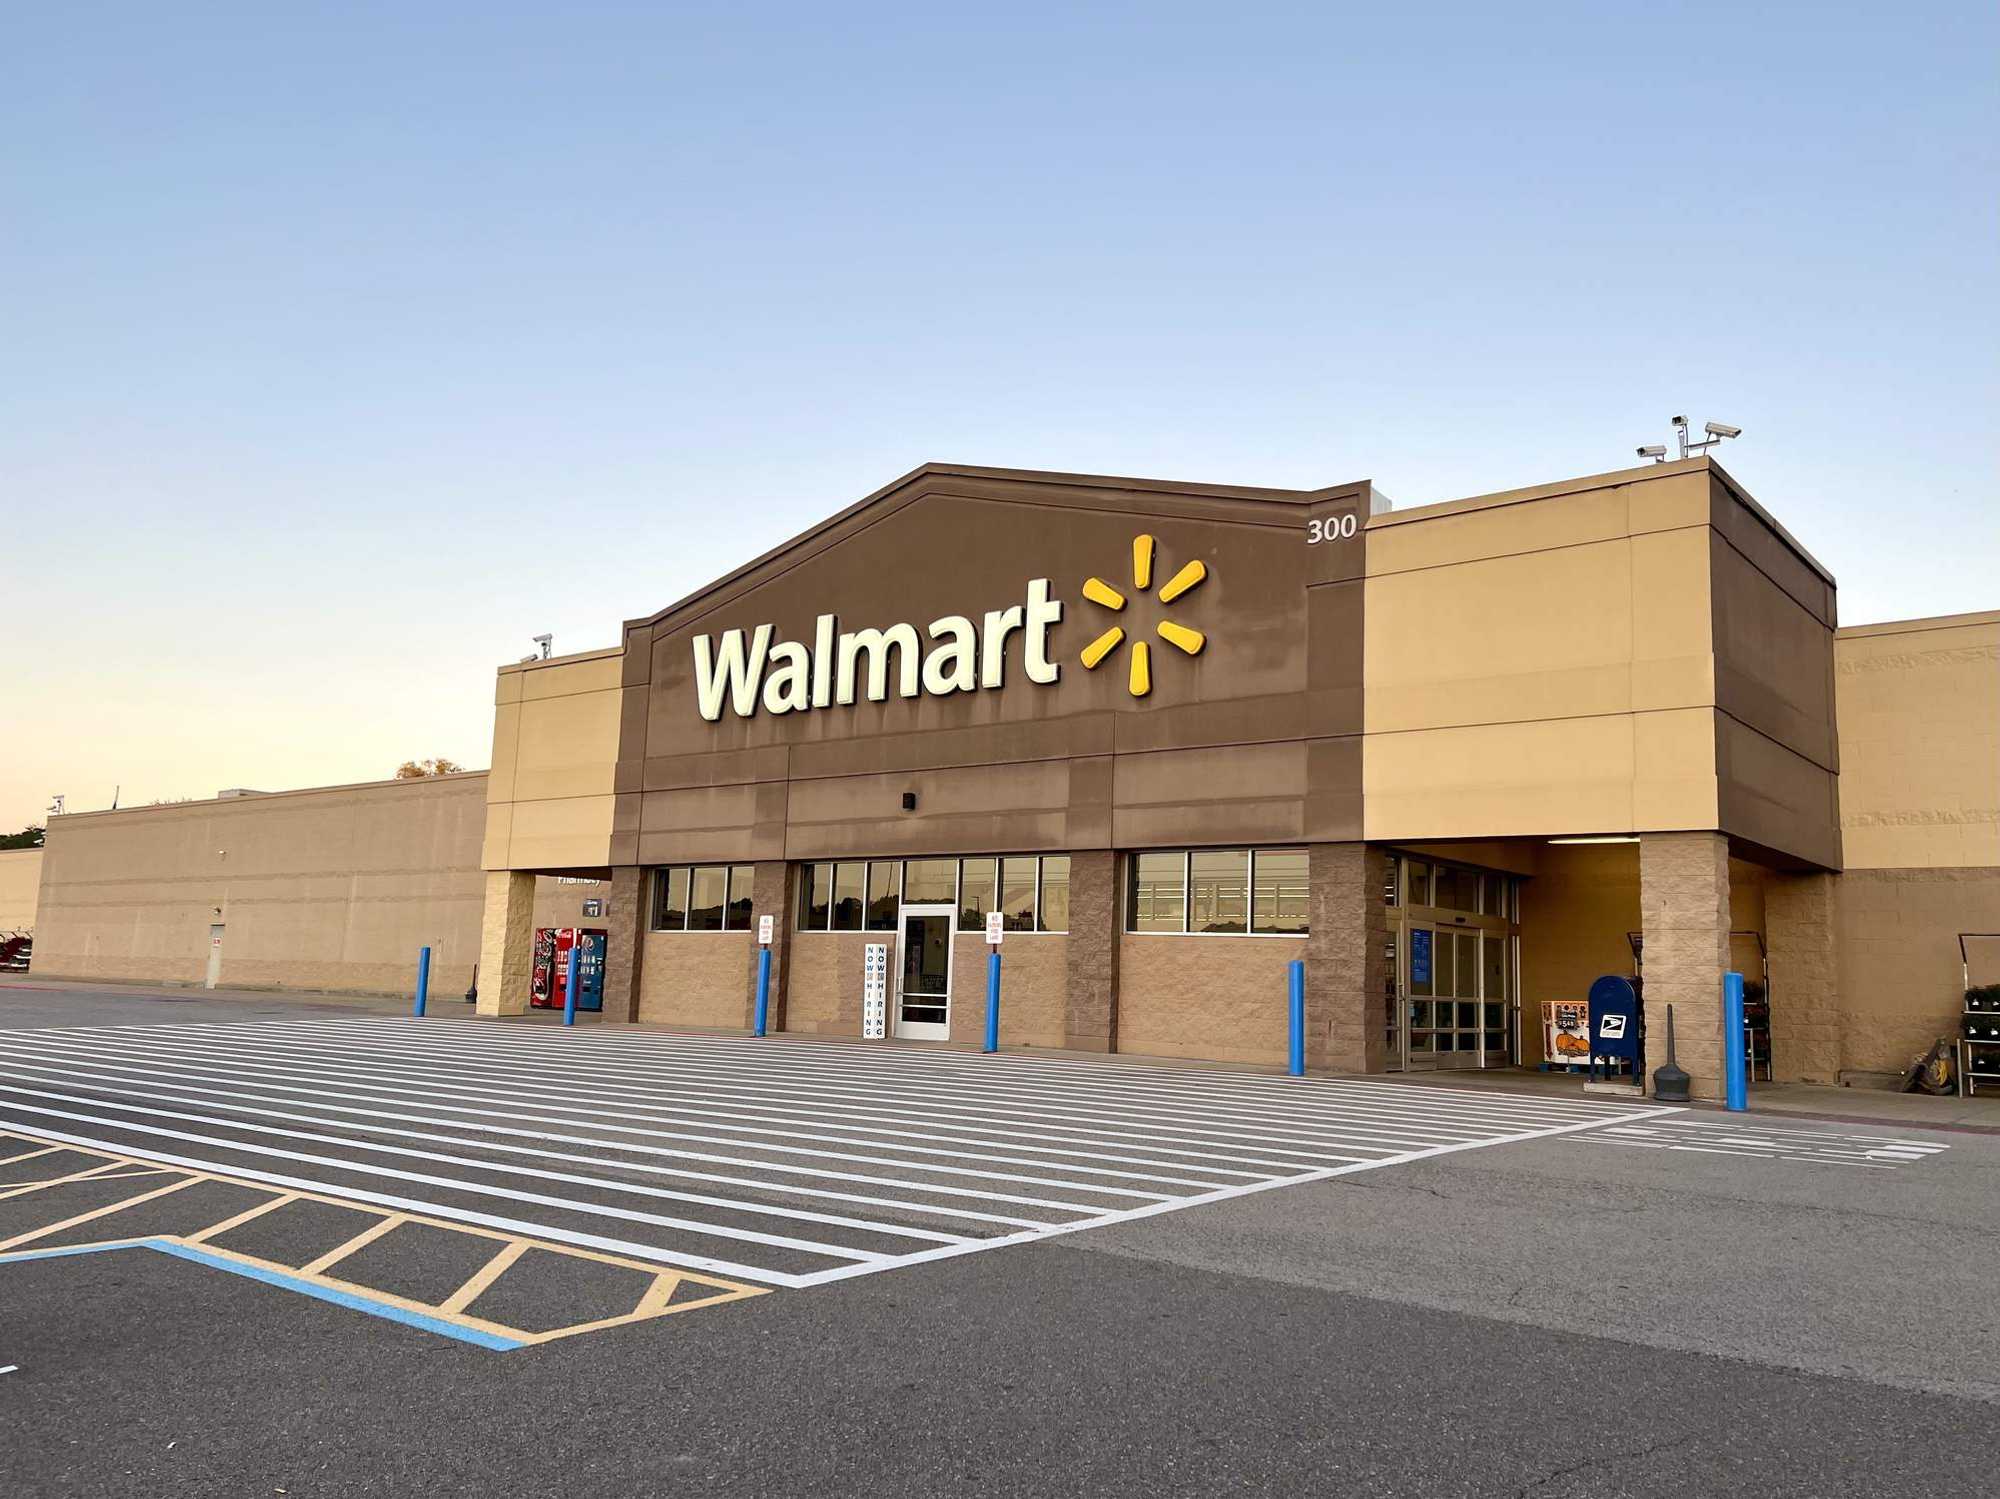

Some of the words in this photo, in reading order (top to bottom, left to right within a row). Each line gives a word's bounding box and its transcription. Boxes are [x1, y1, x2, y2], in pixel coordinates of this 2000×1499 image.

[1307, 514, 1357, 544] 300
[692, 578, 1062, 722] Walmart
[866, 946, 874, 972] NOW
[877, 946, 885, 972] NOW
[865, 983, 873, 1036] HIRING
[876, 983, 884, 1036] HIRING
